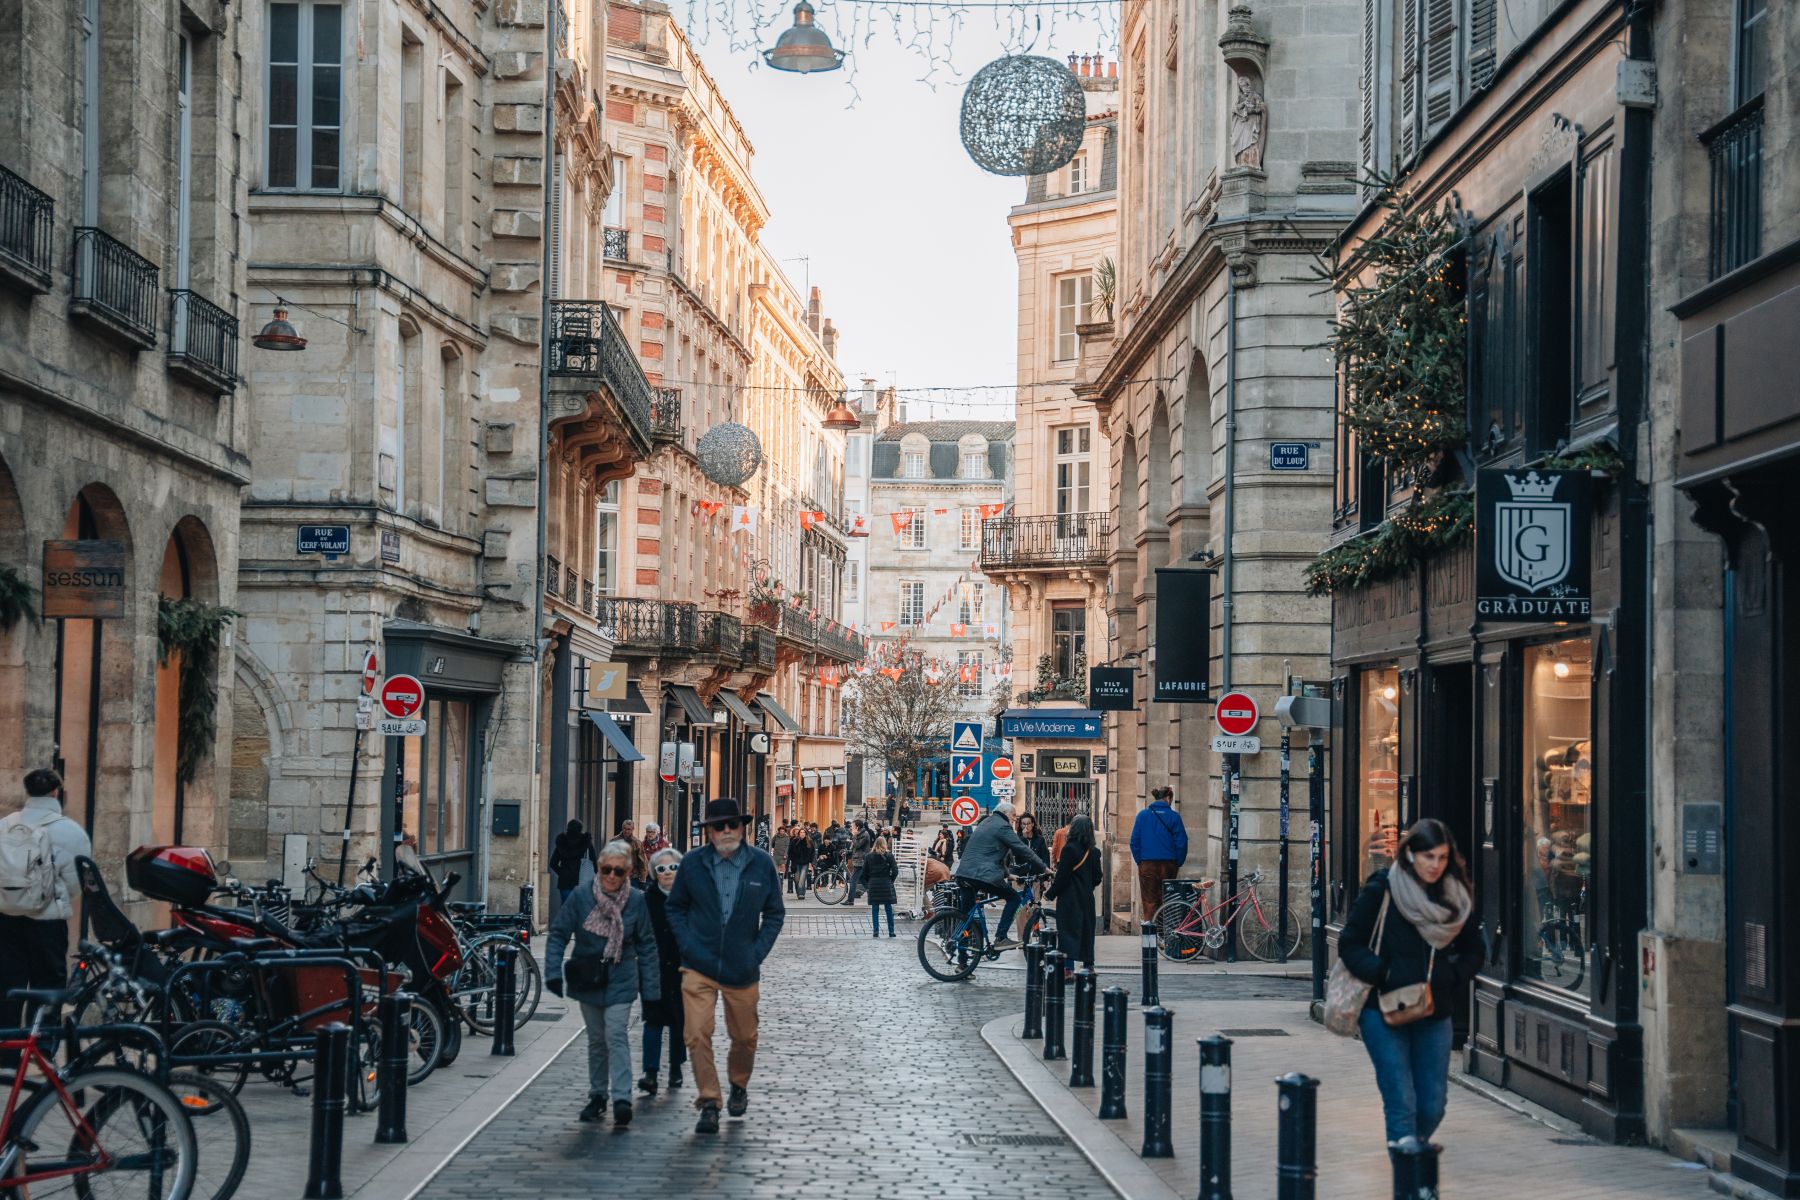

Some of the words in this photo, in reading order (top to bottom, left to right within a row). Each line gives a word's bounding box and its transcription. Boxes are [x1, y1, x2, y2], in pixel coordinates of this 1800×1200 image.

[1515, 525, 1550, 562] G
[1478, 601, 1590, 613] GRADUATE
[1159, 681, 1206, 690] LAFAURIE
[382, 723, 402, 731] SAUF
[1008, 723, 1018, 731] La
[1020, 722, 1033, 732] Vie
[1036, 722, 1075, 732] Moderne
